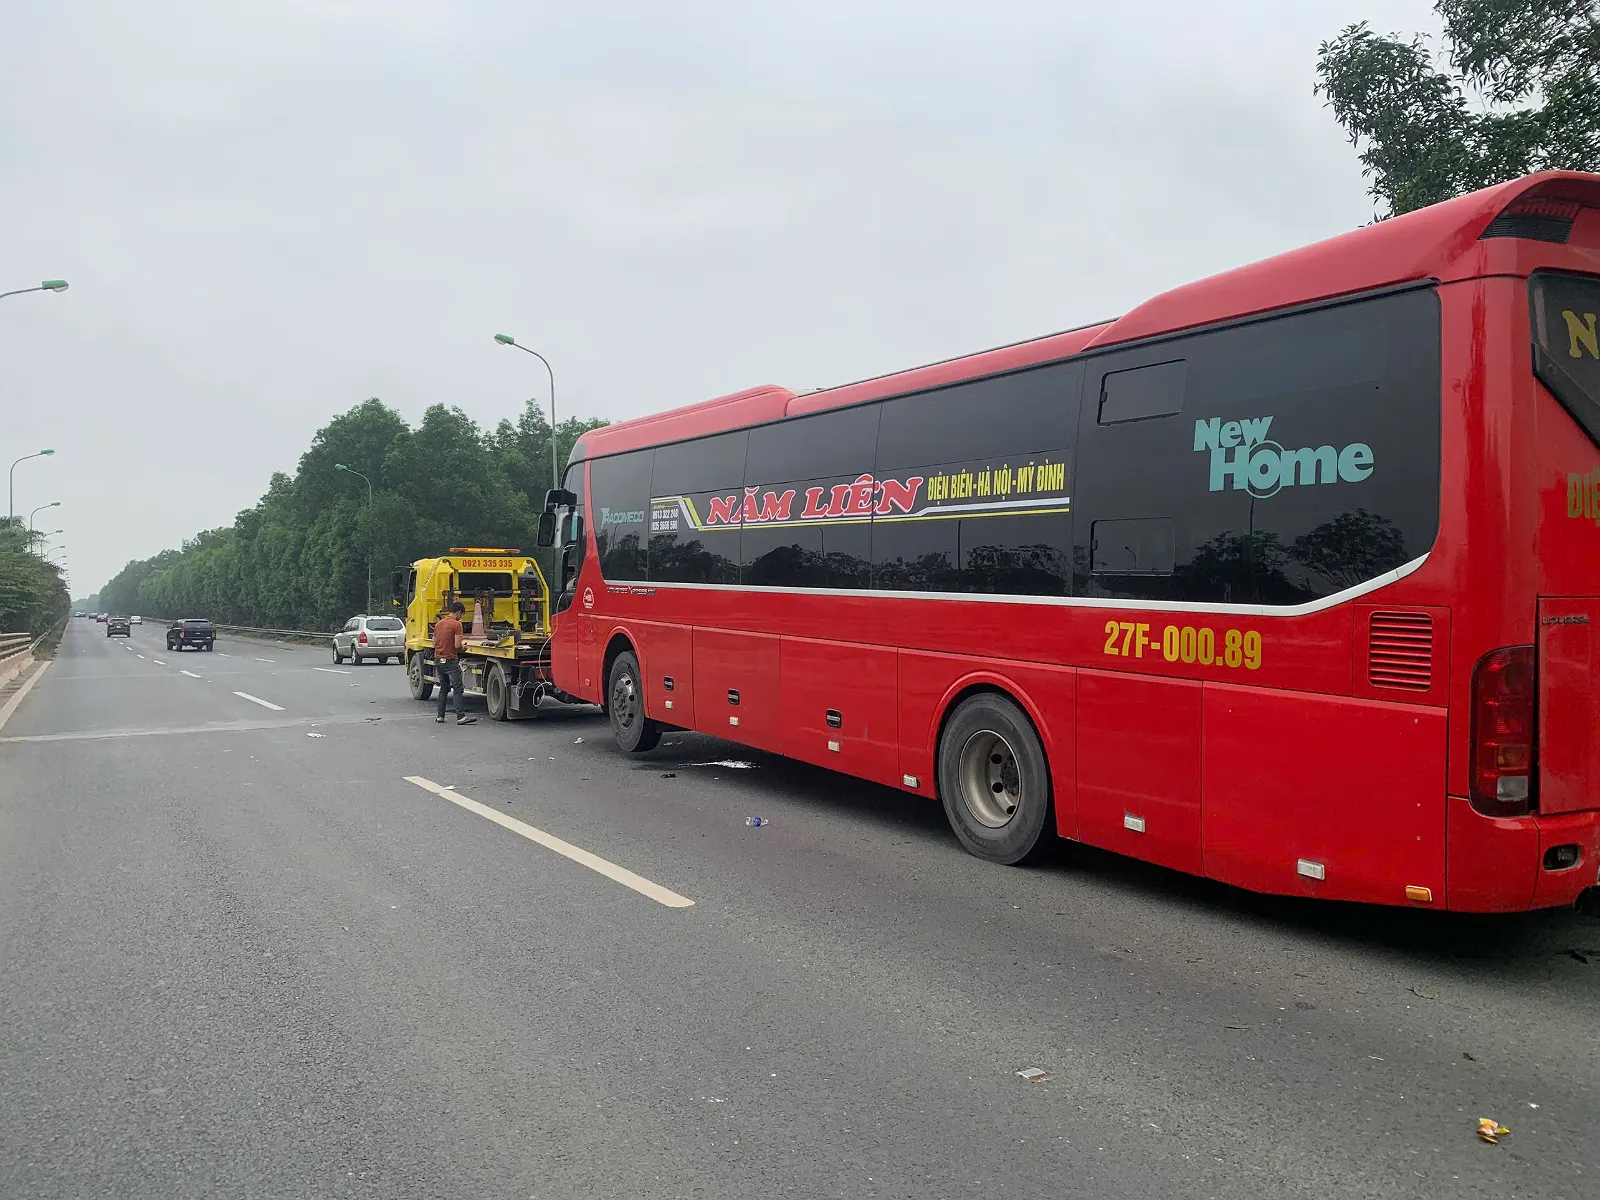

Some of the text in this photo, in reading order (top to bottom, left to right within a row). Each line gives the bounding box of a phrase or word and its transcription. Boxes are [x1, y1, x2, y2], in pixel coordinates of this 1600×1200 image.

[1193, 415, 1274, 451] New
[927, 471, 949, 505] ĐIỆN
[1036, 459, 1065, 492] ĐÌNH
[1209, 441, 1374, 497] Home
[706, 473, 924, 525] NĂM LIÊN
[462, 559, 513, 568] 0921 335 335
[1103, 620, 1262, 670] 27F-000.89
